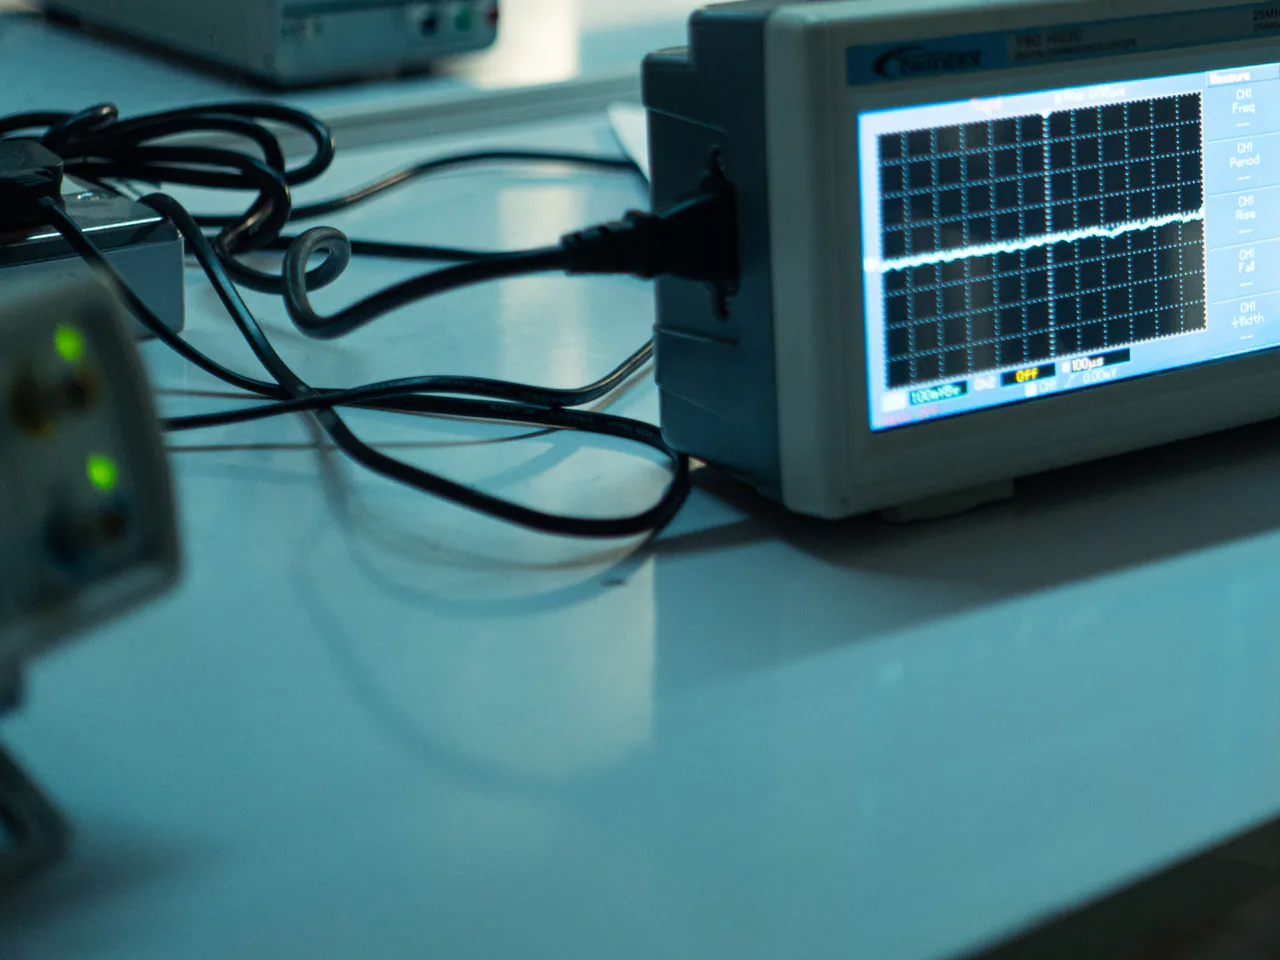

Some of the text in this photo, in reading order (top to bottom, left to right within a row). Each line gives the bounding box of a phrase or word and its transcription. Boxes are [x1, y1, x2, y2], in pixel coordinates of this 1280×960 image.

[1236, 88, 1252, 101] CH1
[1232, 102, 1255, 114] Freq
[1237, 141, 1253, 154] CH1
[1229, 153, 1260, 168] Period
[1238, 195, 1254, 207] CH1
[1235, 209, 1256, 221] Rise
[1239, 248, 1255, 260] CH1
[1238, 261, 1255, 274] Fall
[1240, 301, 1256, 313] CH1
[1015, 367, 1039, 382] Off
